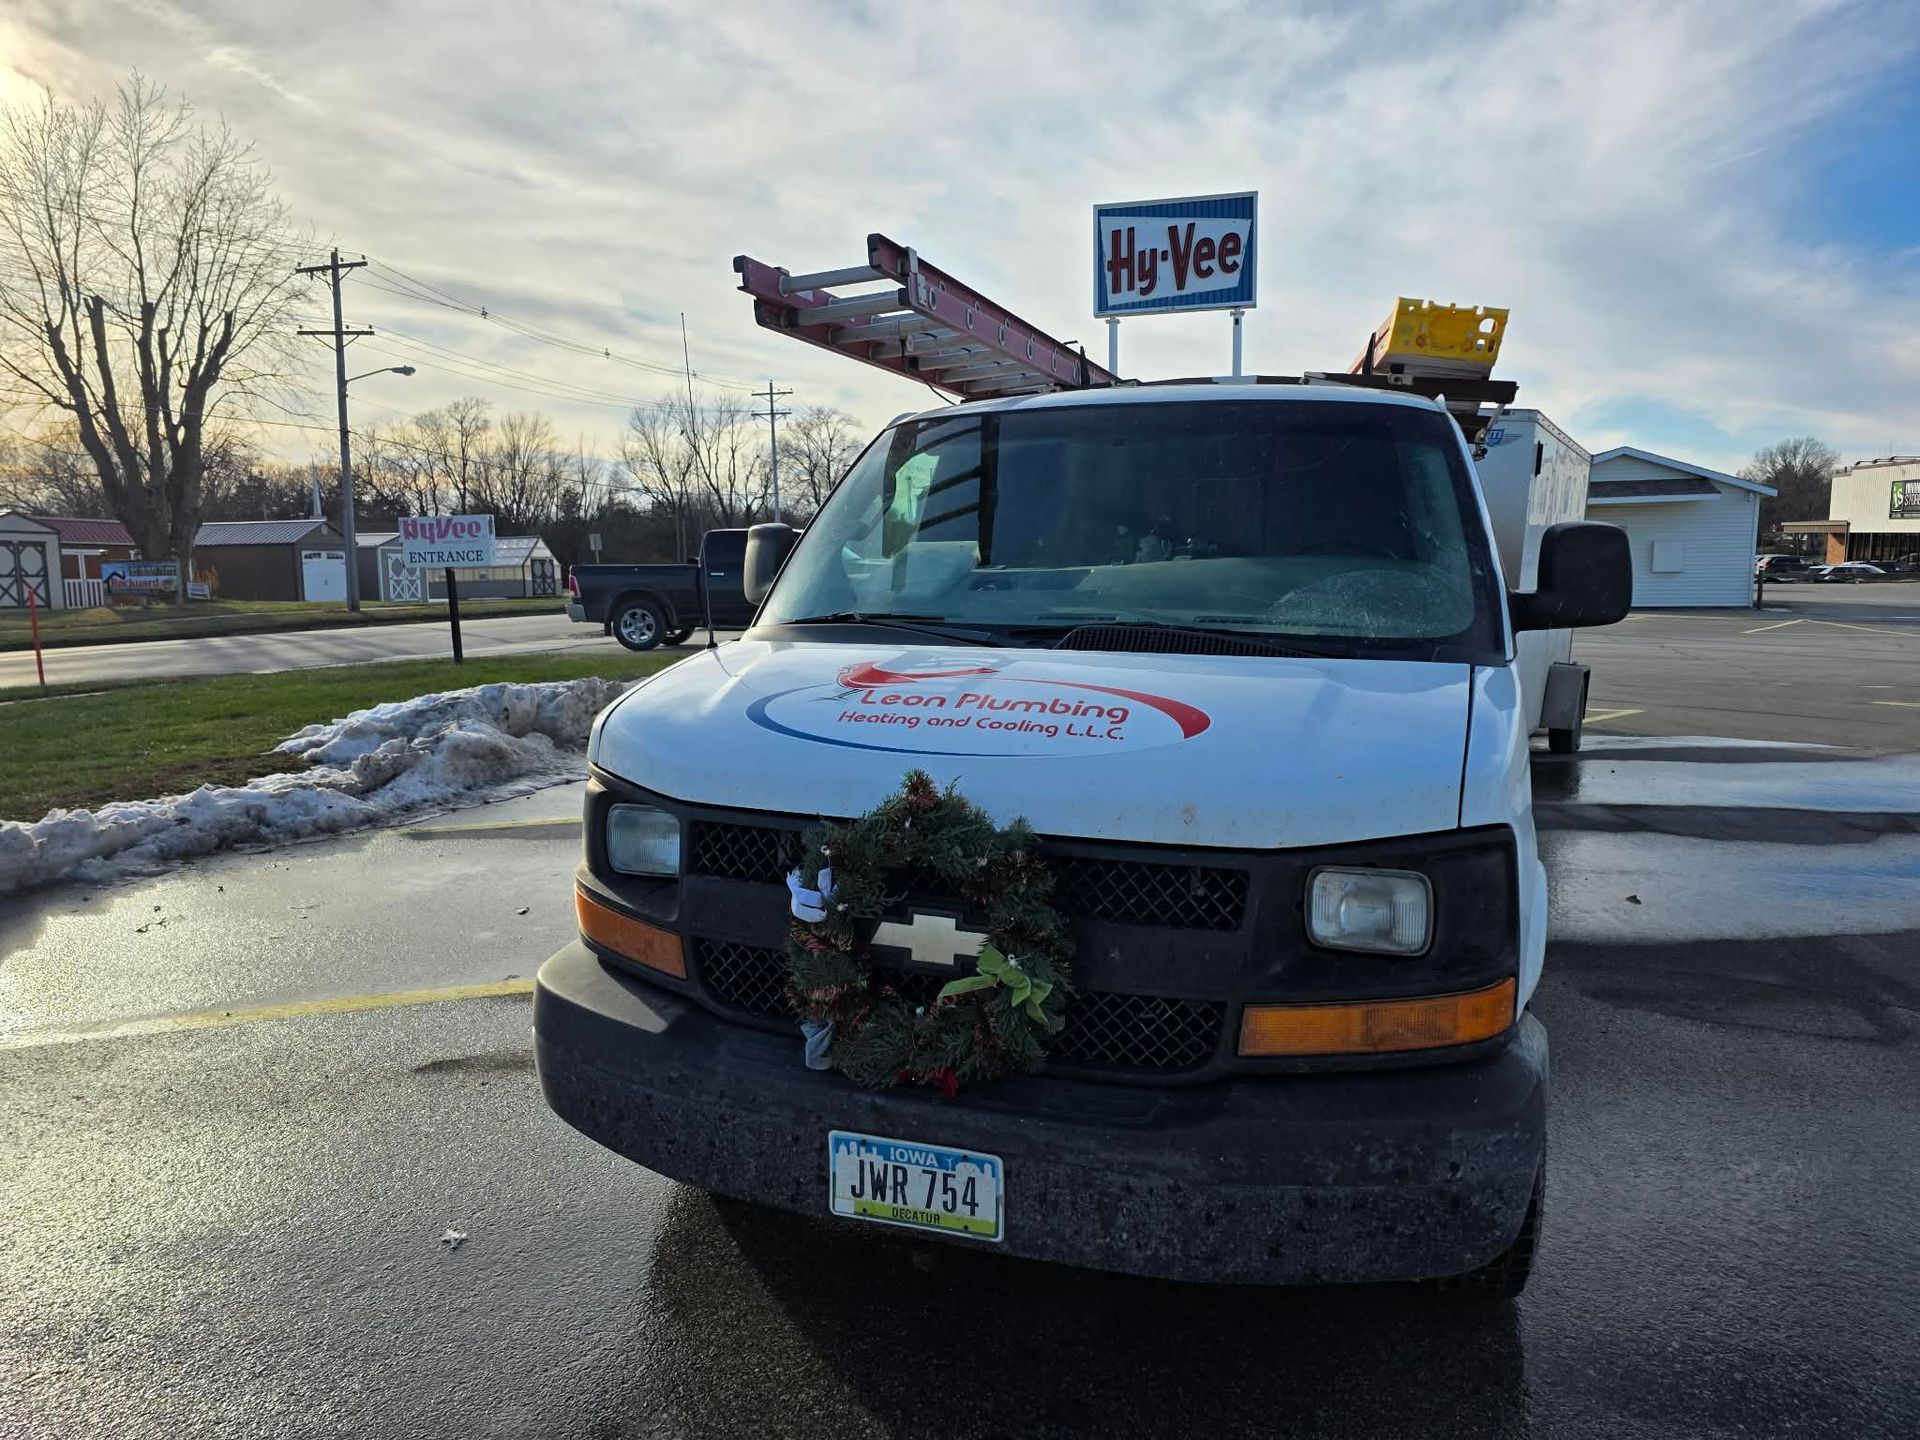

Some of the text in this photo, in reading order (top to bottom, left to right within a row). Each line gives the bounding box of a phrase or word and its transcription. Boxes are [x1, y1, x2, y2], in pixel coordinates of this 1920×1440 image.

[1107, 222, 1242, 296] Hy-Vee
[402, 518, 482, 544] HyVee
[409, 550, 484, 563] ENTRANCE
[860, 689, 1130, 725] Leon Plumbing
[837, 711, 1125, 740] Heating and Cooling L.L.C.
[889, 1146, 939, 1168] IOWA
[850, 1159, 980, 1217] JWR 754
[891, 1207, 941, 1225] DECATUR
